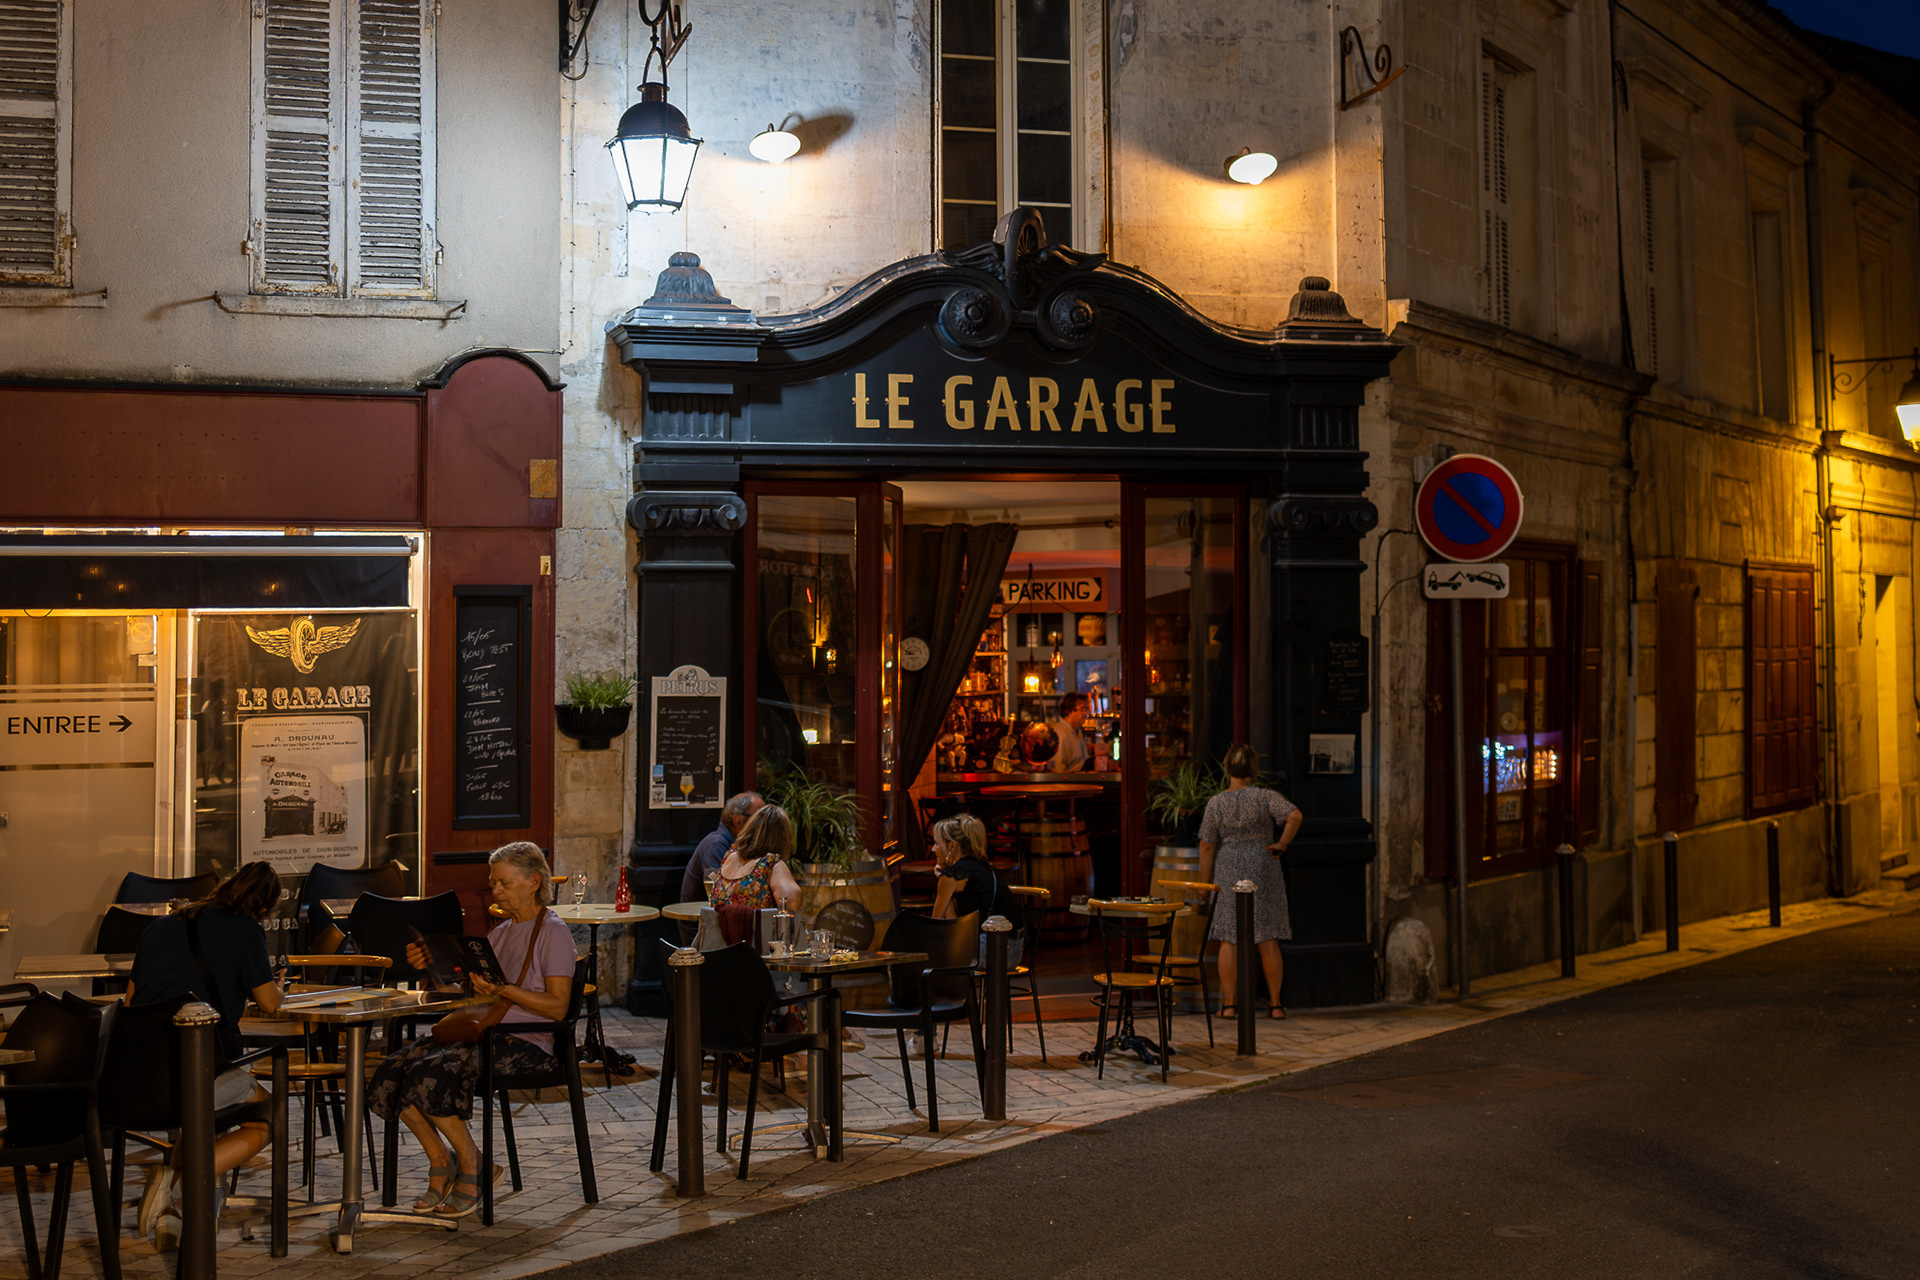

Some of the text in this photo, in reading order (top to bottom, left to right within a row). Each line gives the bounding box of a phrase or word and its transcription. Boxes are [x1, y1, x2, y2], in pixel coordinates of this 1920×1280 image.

[852, 373, 1176, 433] LE GARAGE
[1009, 581, 1090, 601] PARKING
[661, 680, 718, 696] PETRUS
[236, 685, 371, 711] LE GARAGE
[8, 715, 101, 734] ENTREE
[288, 734, 335, 742] DROUNAU
[269, 778, 312, 788] AUTOMOBILE
[274, 771, 307, 781] GARAGE
[252, 848, 298, 857] AUTOMOBILES
